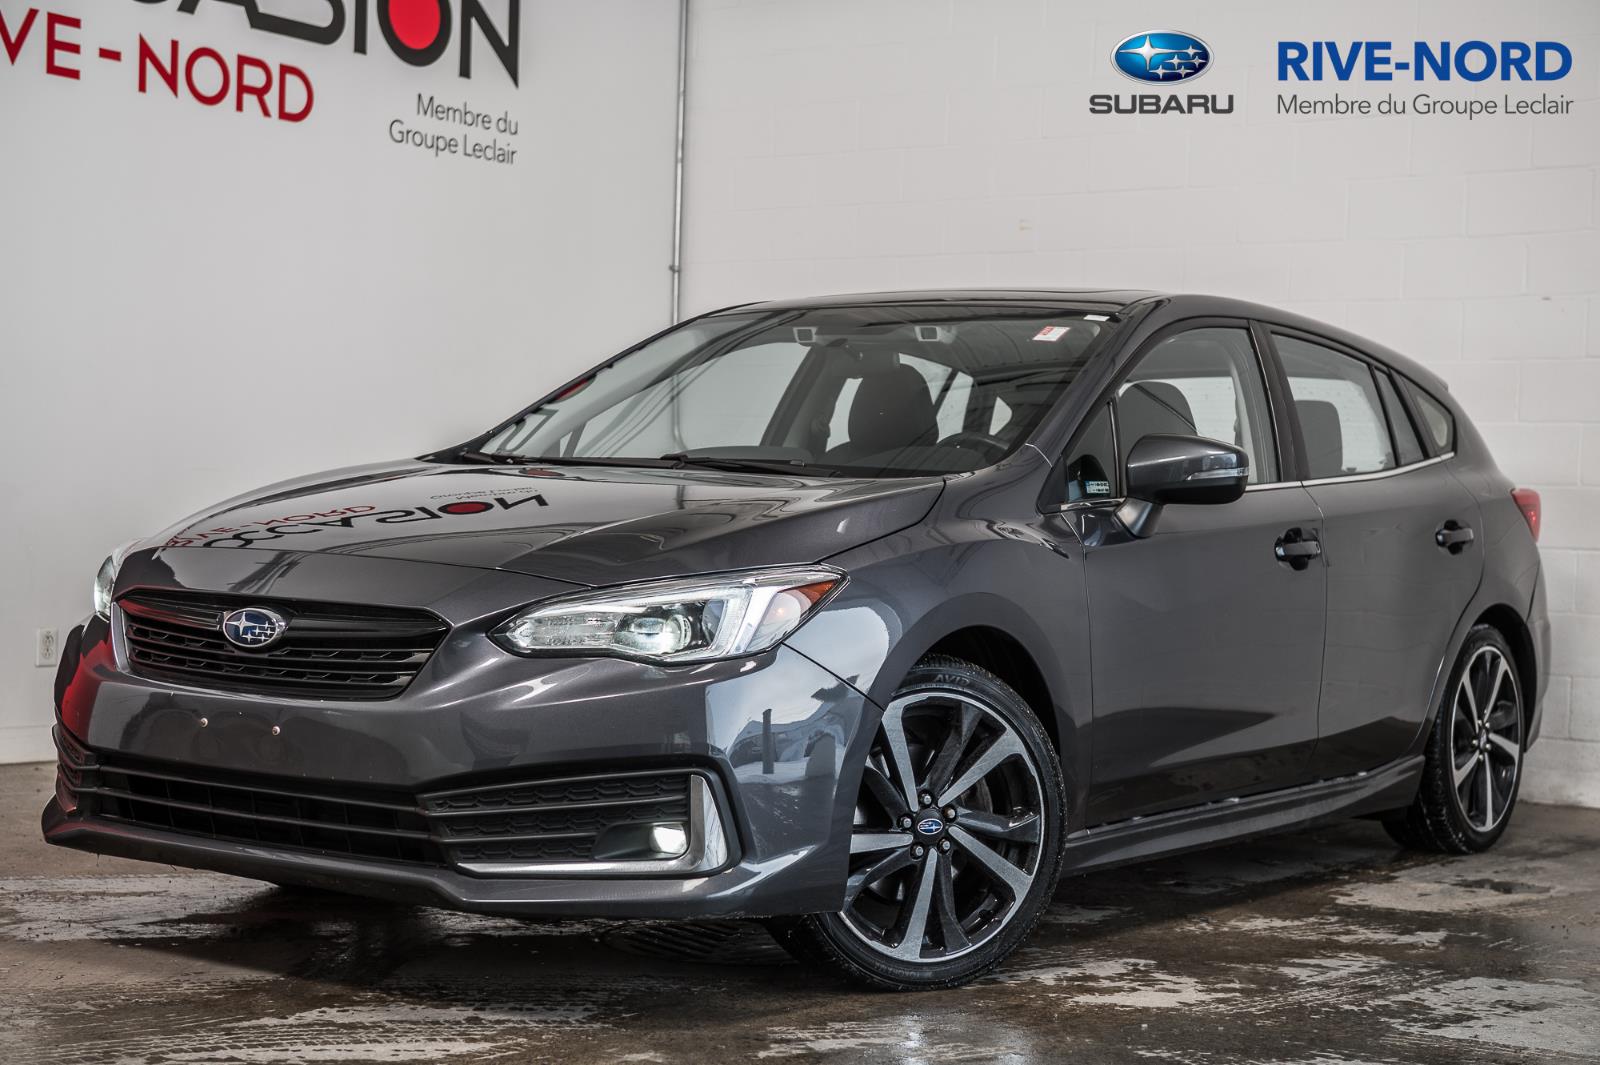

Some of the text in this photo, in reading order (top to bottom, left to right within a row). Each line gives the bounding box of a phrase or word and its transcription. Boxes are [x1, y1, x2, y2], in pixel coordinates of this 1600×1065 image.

[417, 93, 518, 135] Membre du
[389, 118, 517, 164] Groupe Leclair
